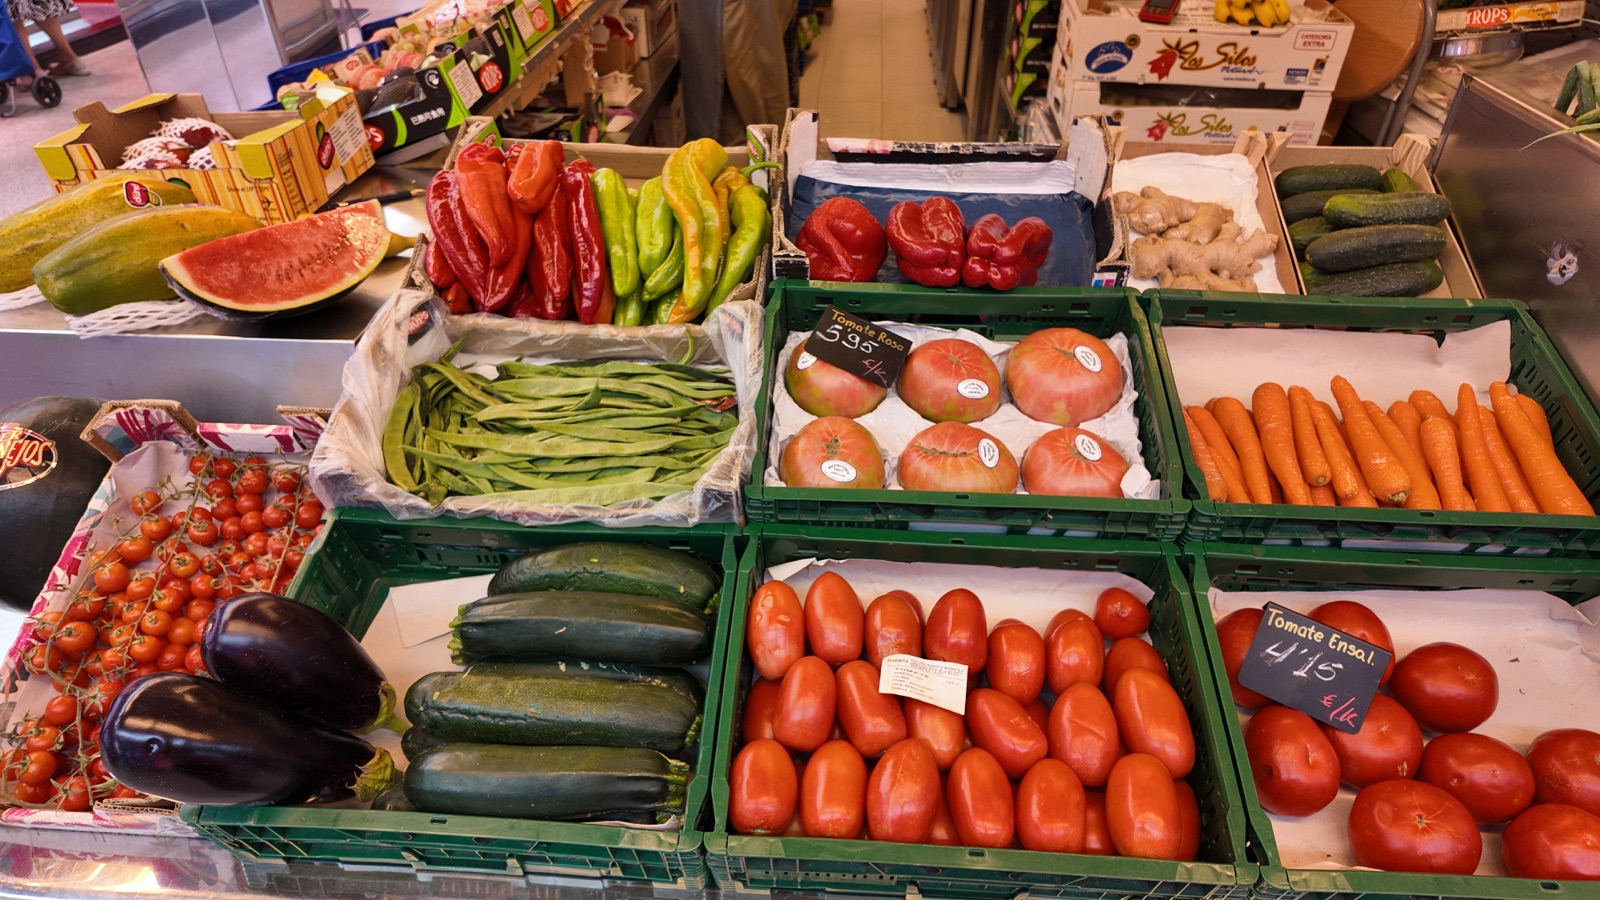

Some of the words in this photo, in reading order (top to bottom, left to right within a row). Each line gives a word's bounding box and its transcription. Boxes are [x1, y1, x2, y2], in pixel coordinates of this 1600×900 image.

[1216, 42, 1257, 67] Silos
[1200, 114, 1232, 133] Silos
[831, 308, 875, 337] Tomate
[877, 332, 905, 352] Rosa
[1266, 607, 1324, 643] Tomate
[1329, 633, 1375, 667] Ensal.
